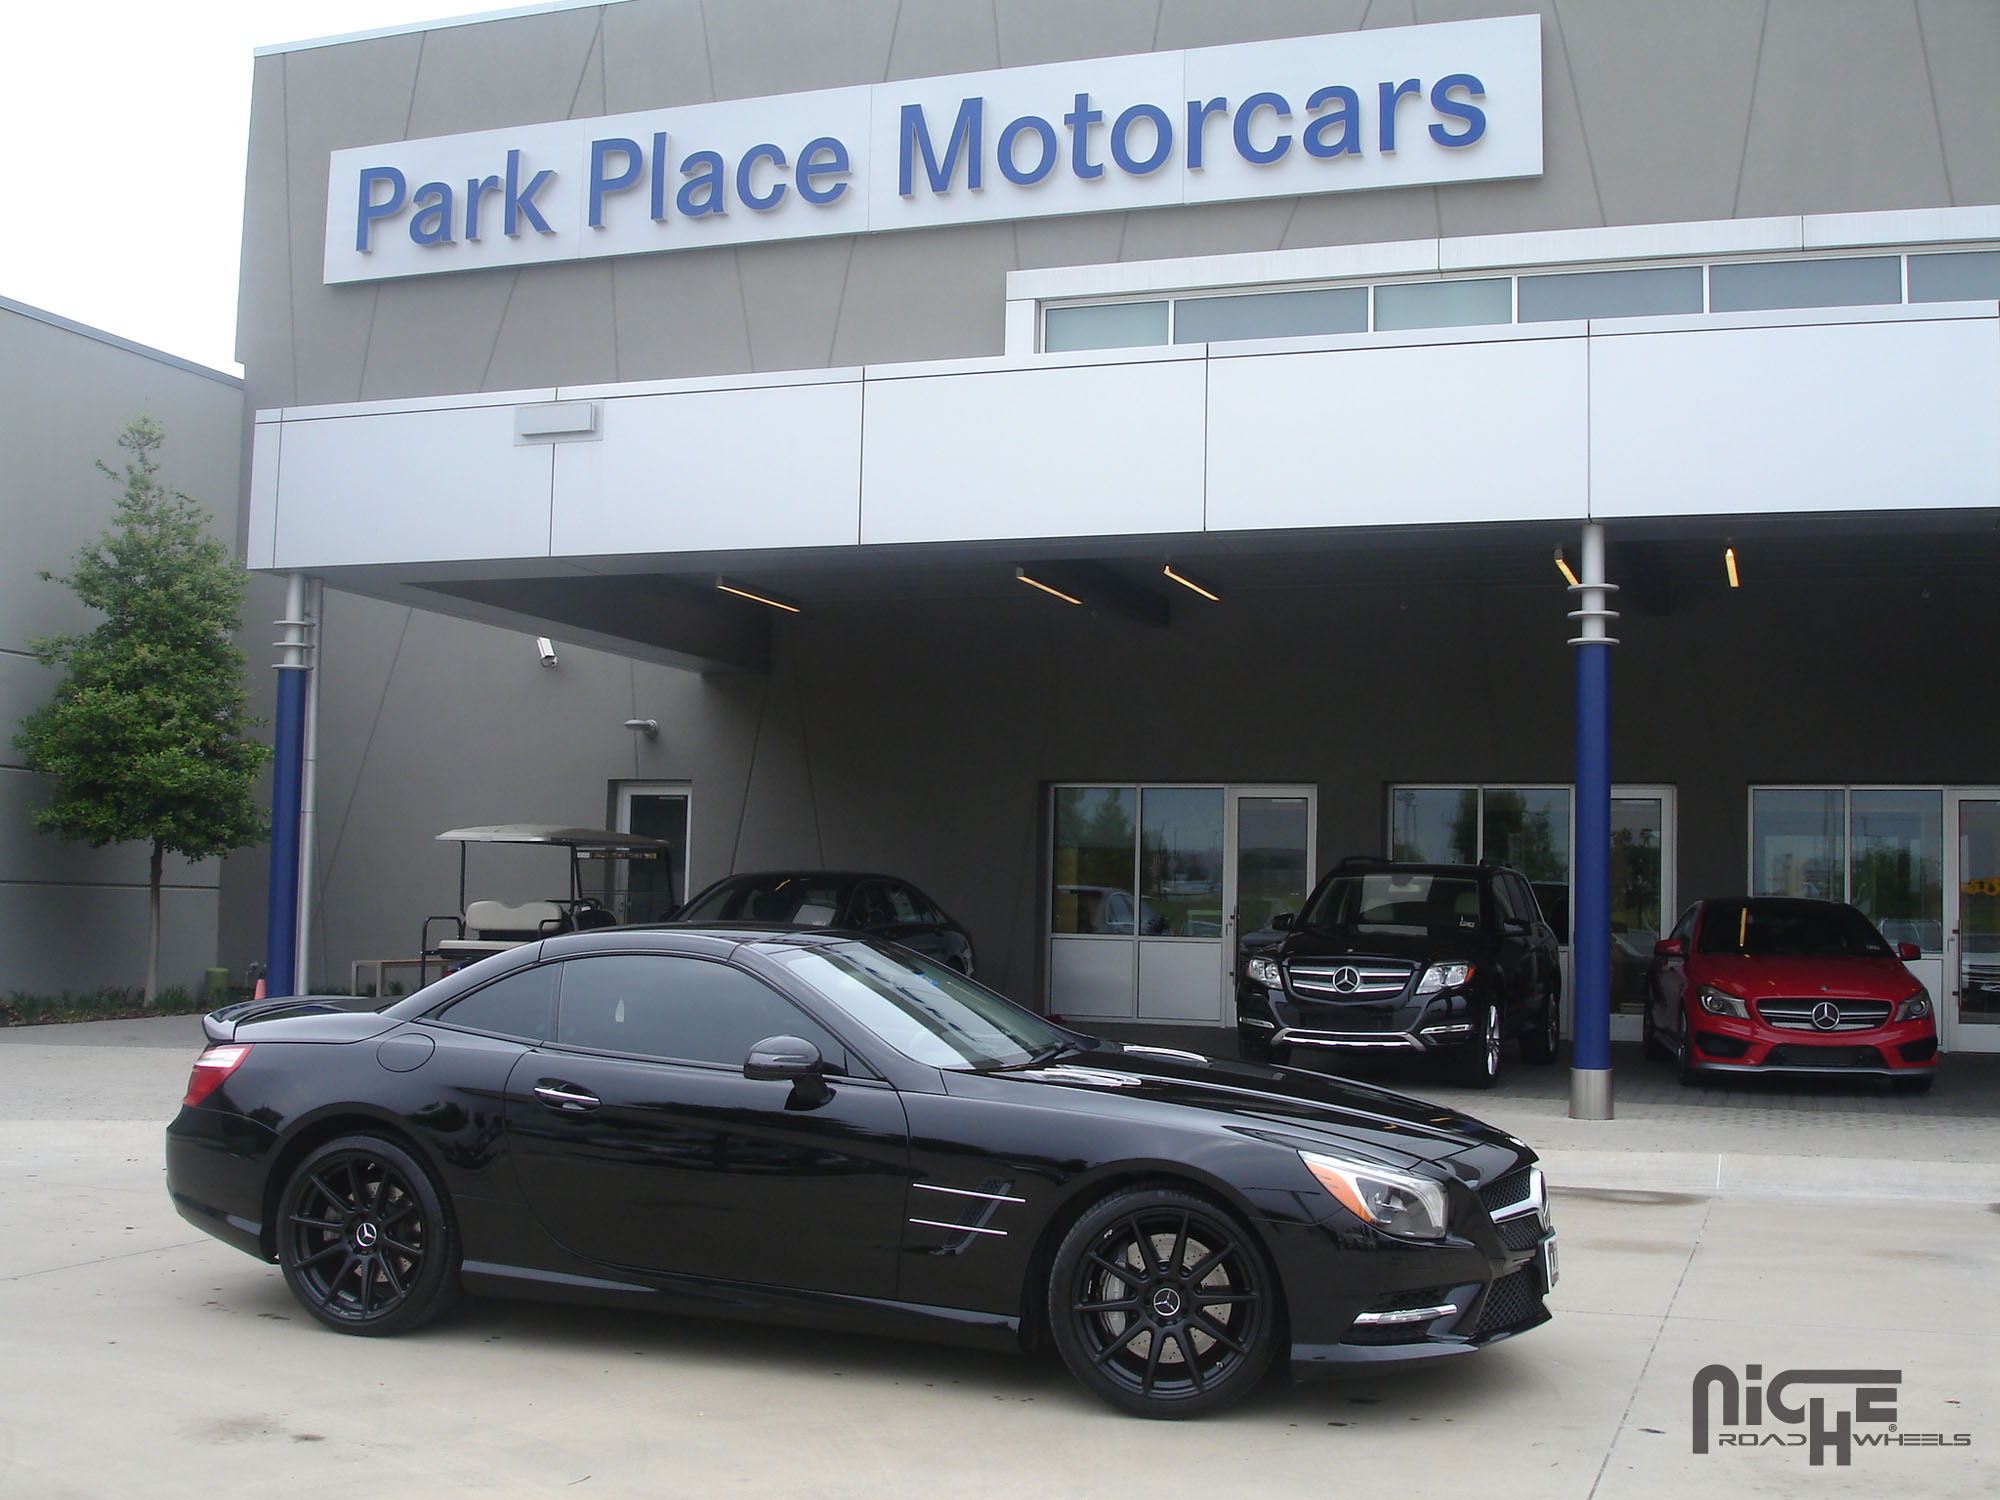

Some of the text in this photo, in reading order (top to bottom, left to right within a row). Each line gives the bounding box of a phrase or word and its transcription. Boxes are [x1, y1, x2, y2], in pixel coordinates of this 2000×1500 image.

[355, 73, 1487, 252] Park Place Motorcars
